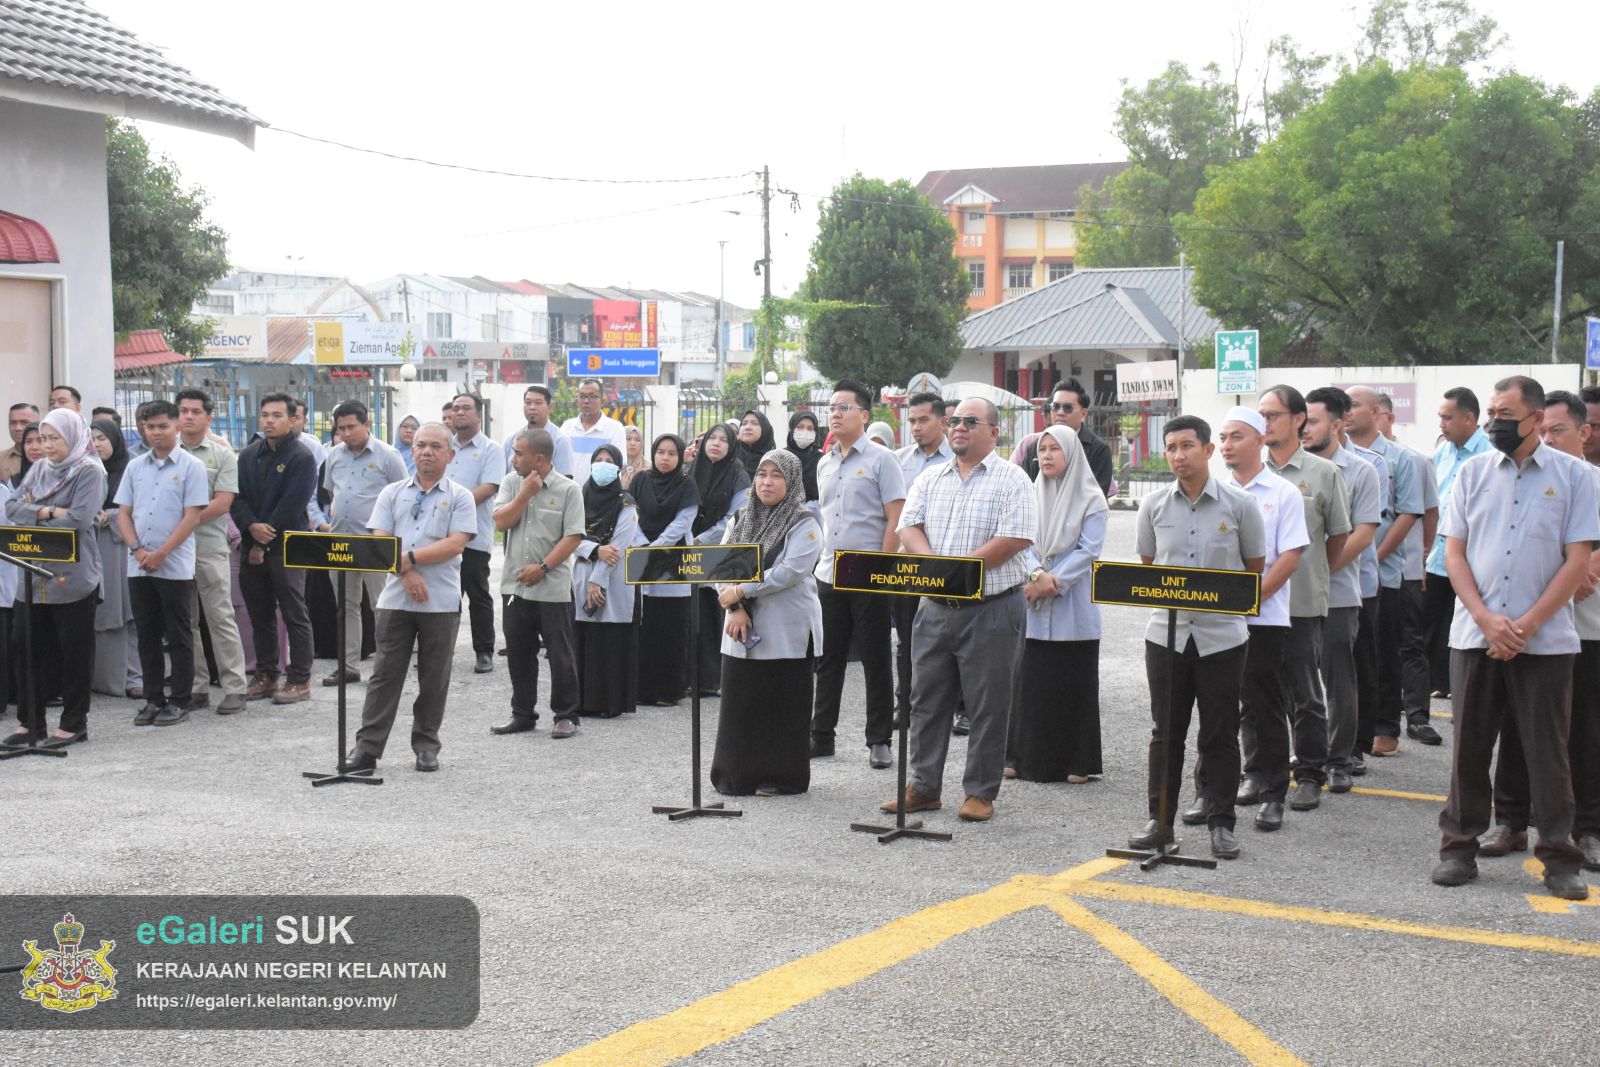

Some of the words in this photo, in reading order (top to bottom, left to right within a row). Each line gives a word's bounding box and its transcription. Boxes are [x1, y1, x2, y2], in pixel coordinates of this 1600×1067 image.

[317, 337, 340, 348] etiqa
[440, 342, 466, 350] AGRO
[350, 341, 383, 354] Zieman
[385, 341, 417, 357] Agey
[440, 349, 466, 357] BANK
[622, 359, 656, 368] Terengganu
[1121, 380, 1150, 394] TANDAS
[1152, 379, 1174, 393] AWAM
[1225, 383, 1243, 391] ZON
[1245, 382, 1251, 390] A
[16, 533, 33, 543] UNIT
[8, 543, 43, 553] TEKNIKAL
[331, 542, 350, 552] UNIT
[327, 552, 353, 562] TANAH
[682, 553, 704, 563] UNIT
[678, 566, 704, 575] HASIL
[896, 563, 920, 574] UNIT
[870, 573, 945, 588] PENDAFTARAN
[1161, 575, 1187, 588] UNIT
[1131, 586, 1219, 602] PEMBANGUNAN
